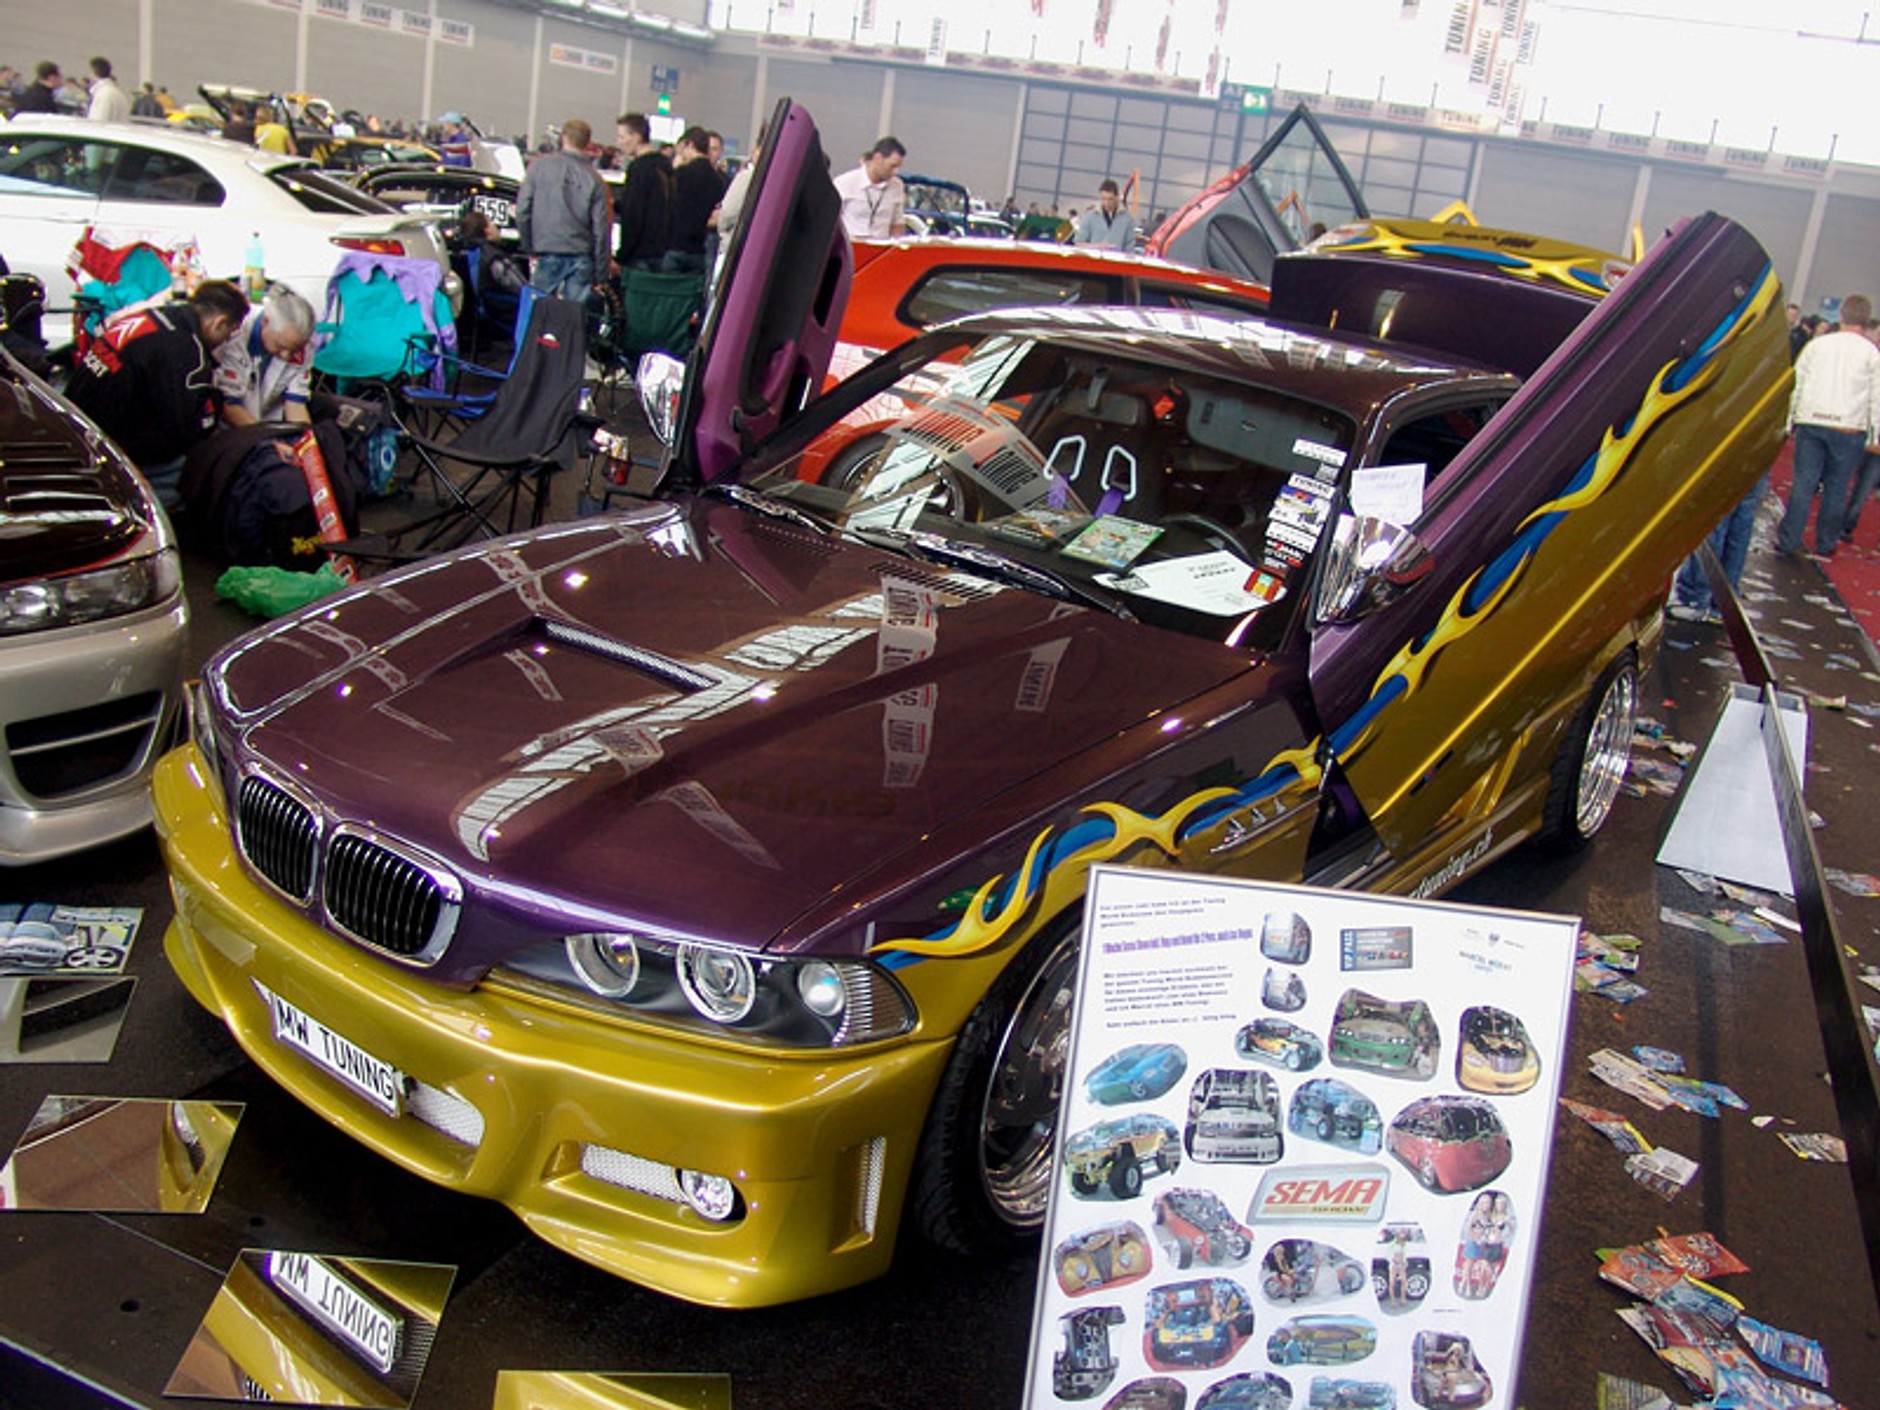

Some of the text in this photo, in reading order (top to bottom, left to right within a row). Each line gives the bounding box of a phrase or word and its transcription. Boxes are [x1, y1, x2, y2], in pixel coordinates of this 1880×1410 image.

[1469, 28, 1492, 84] TUNING
[277, 998, 394, 1101] MW TUNING
[1264, 1179, 1383, 1205] SEMA
